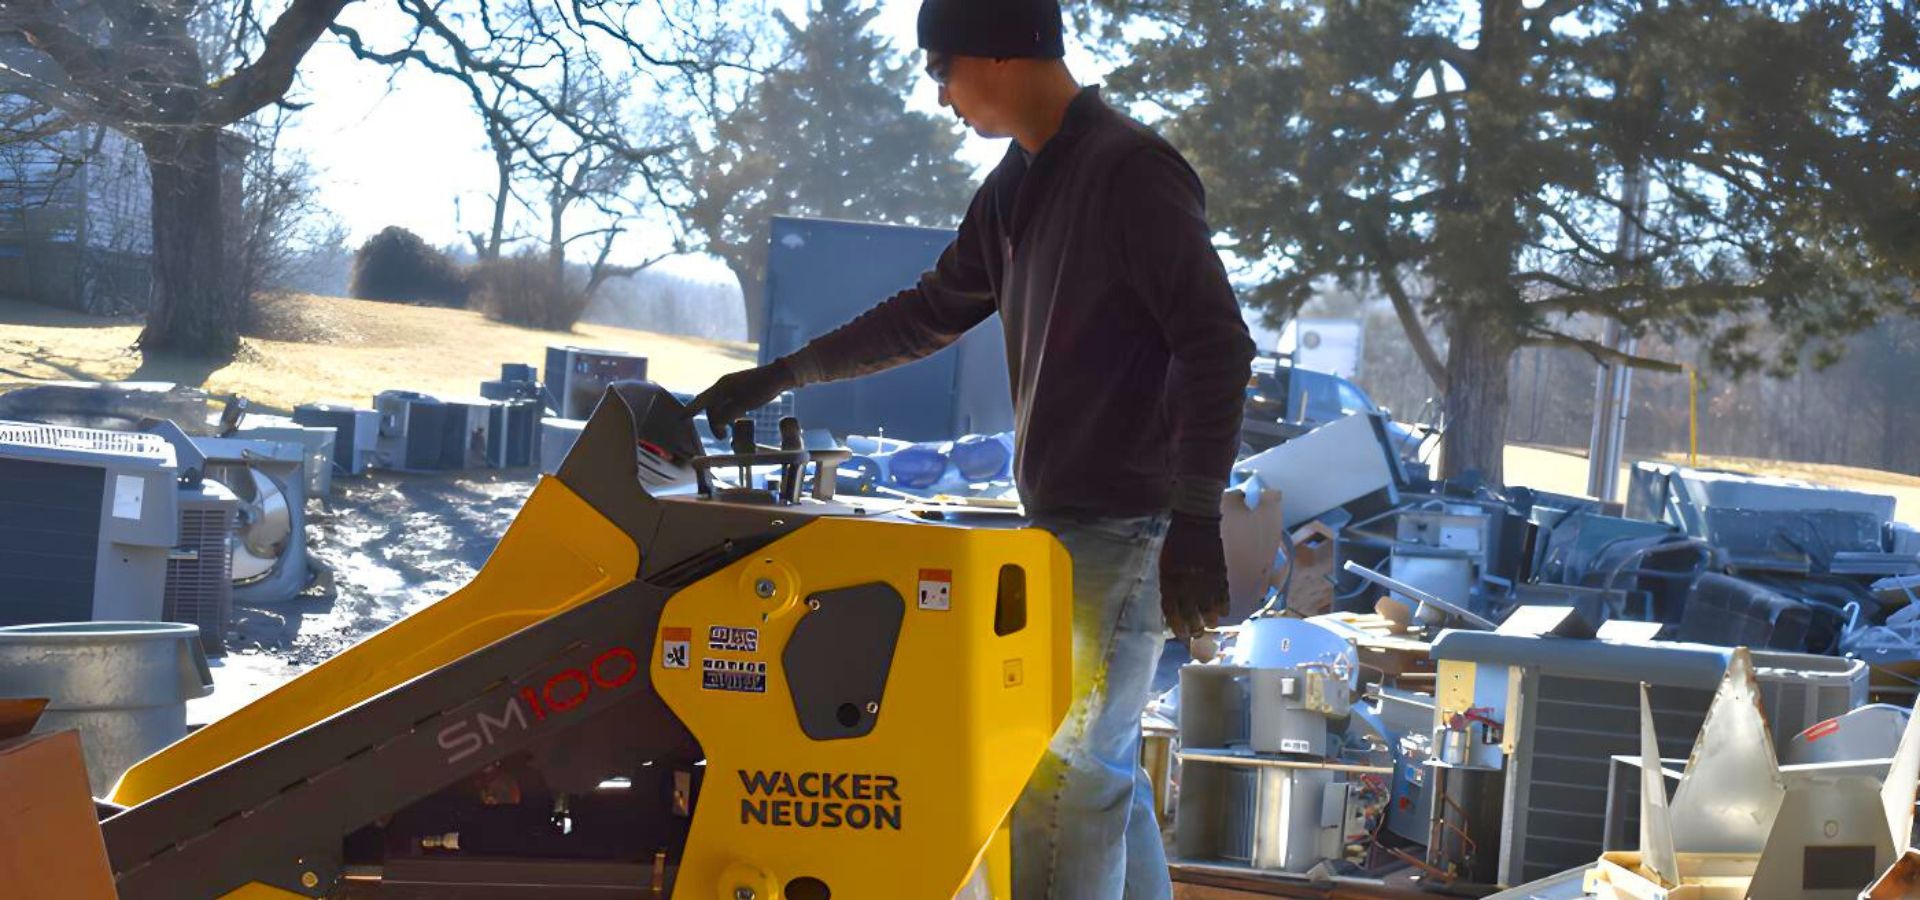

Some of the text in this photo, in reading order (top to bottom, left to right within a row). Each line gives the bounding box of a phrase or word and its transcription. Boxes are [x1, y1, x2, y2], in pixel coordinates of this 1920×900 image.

[437, 646, 638, 764] SM100
[738, 770, 901, 801] WACKER
[741, 799, 902, 830] NEUSON
